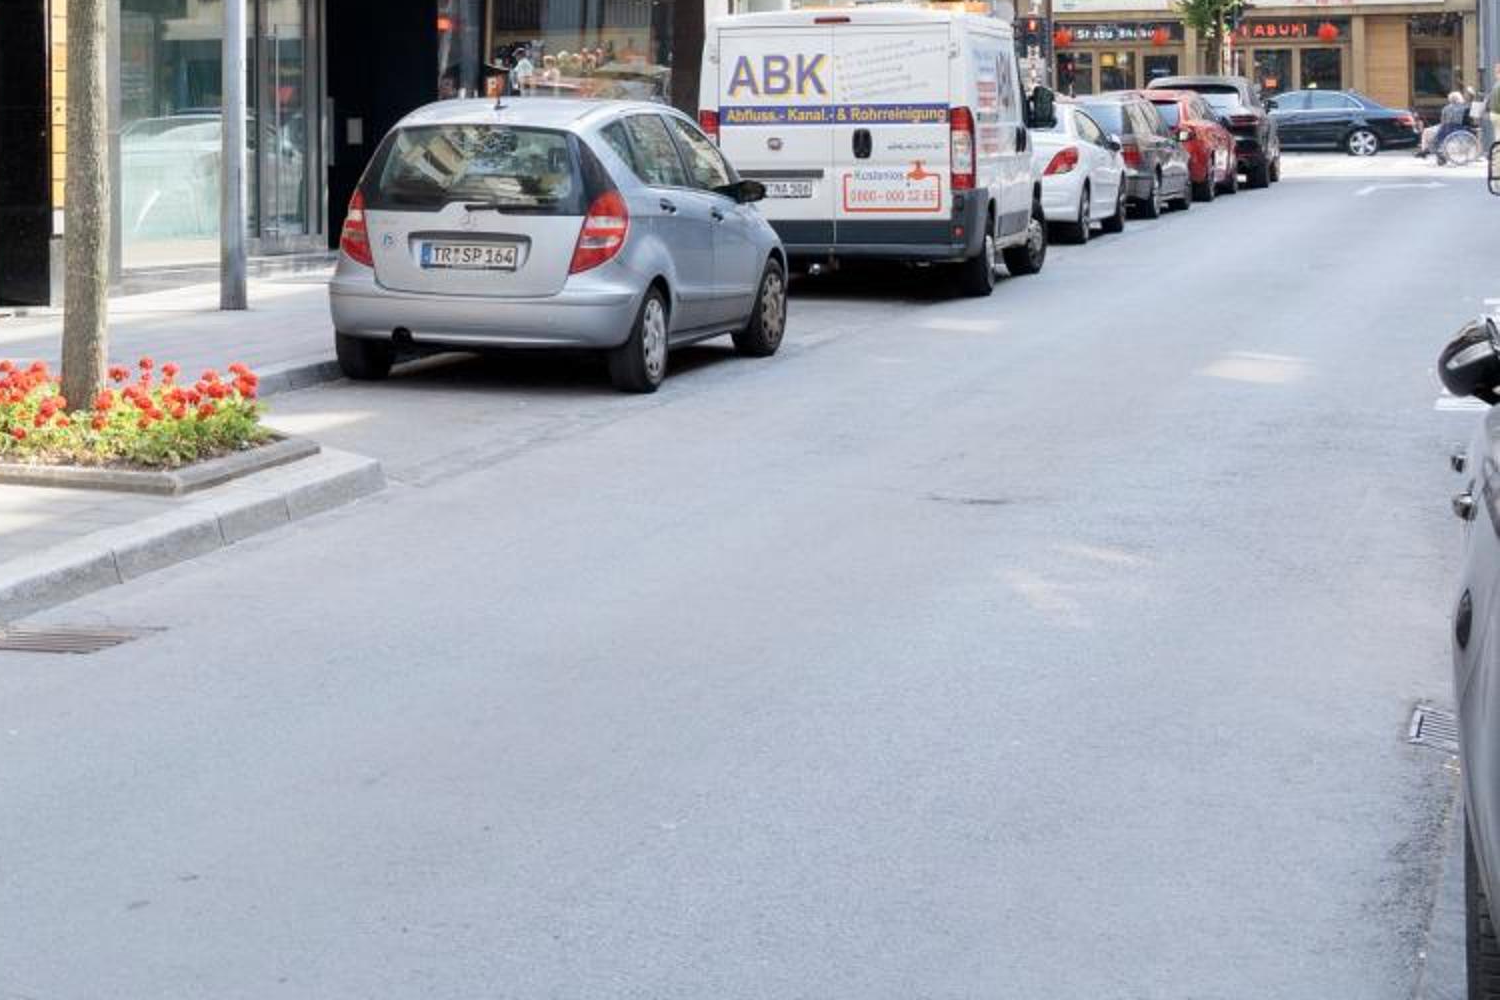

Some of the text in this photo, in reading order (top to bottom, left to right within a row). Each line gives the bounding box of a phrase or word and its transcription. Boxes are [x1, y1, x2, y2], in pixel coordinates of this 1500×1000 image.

[728, 53, 827, 97] ABK
[836, 108, 846, 121] &
[851, 105, 946, 124] Rohrreinigung
[434, 247, 513, 264] TR SP 164
